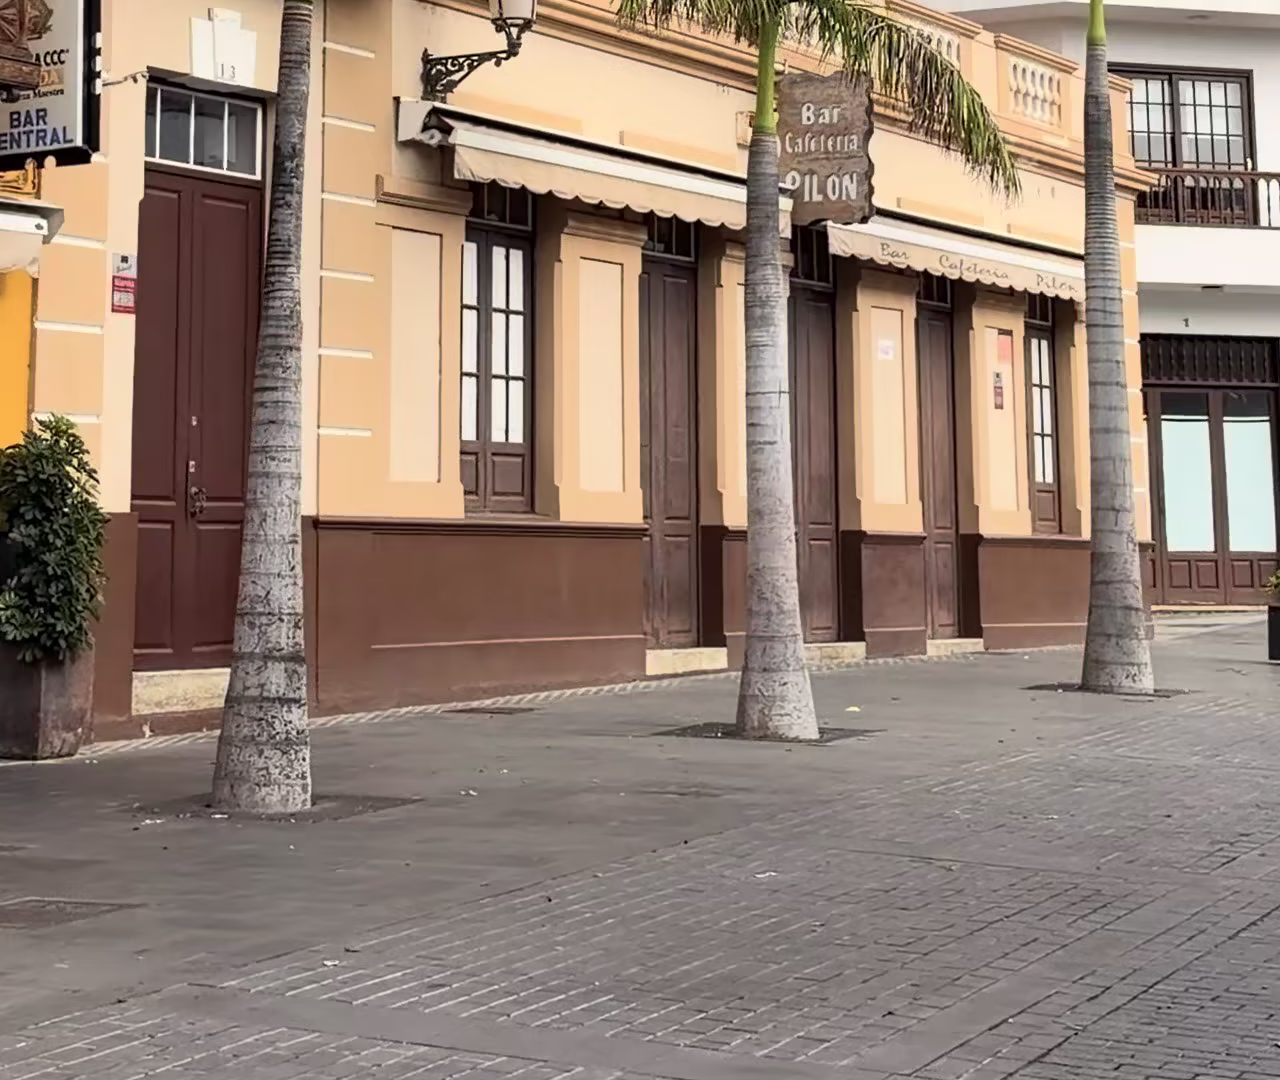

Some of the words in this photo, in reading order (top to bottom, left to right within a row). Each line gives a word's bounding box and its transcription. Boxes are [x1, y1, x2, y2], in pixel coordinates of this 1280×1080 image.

[9, 108, 48, 130] BAR
[802, 103, 841, 125] Bar
[880, 242, 910, 261] Bar
